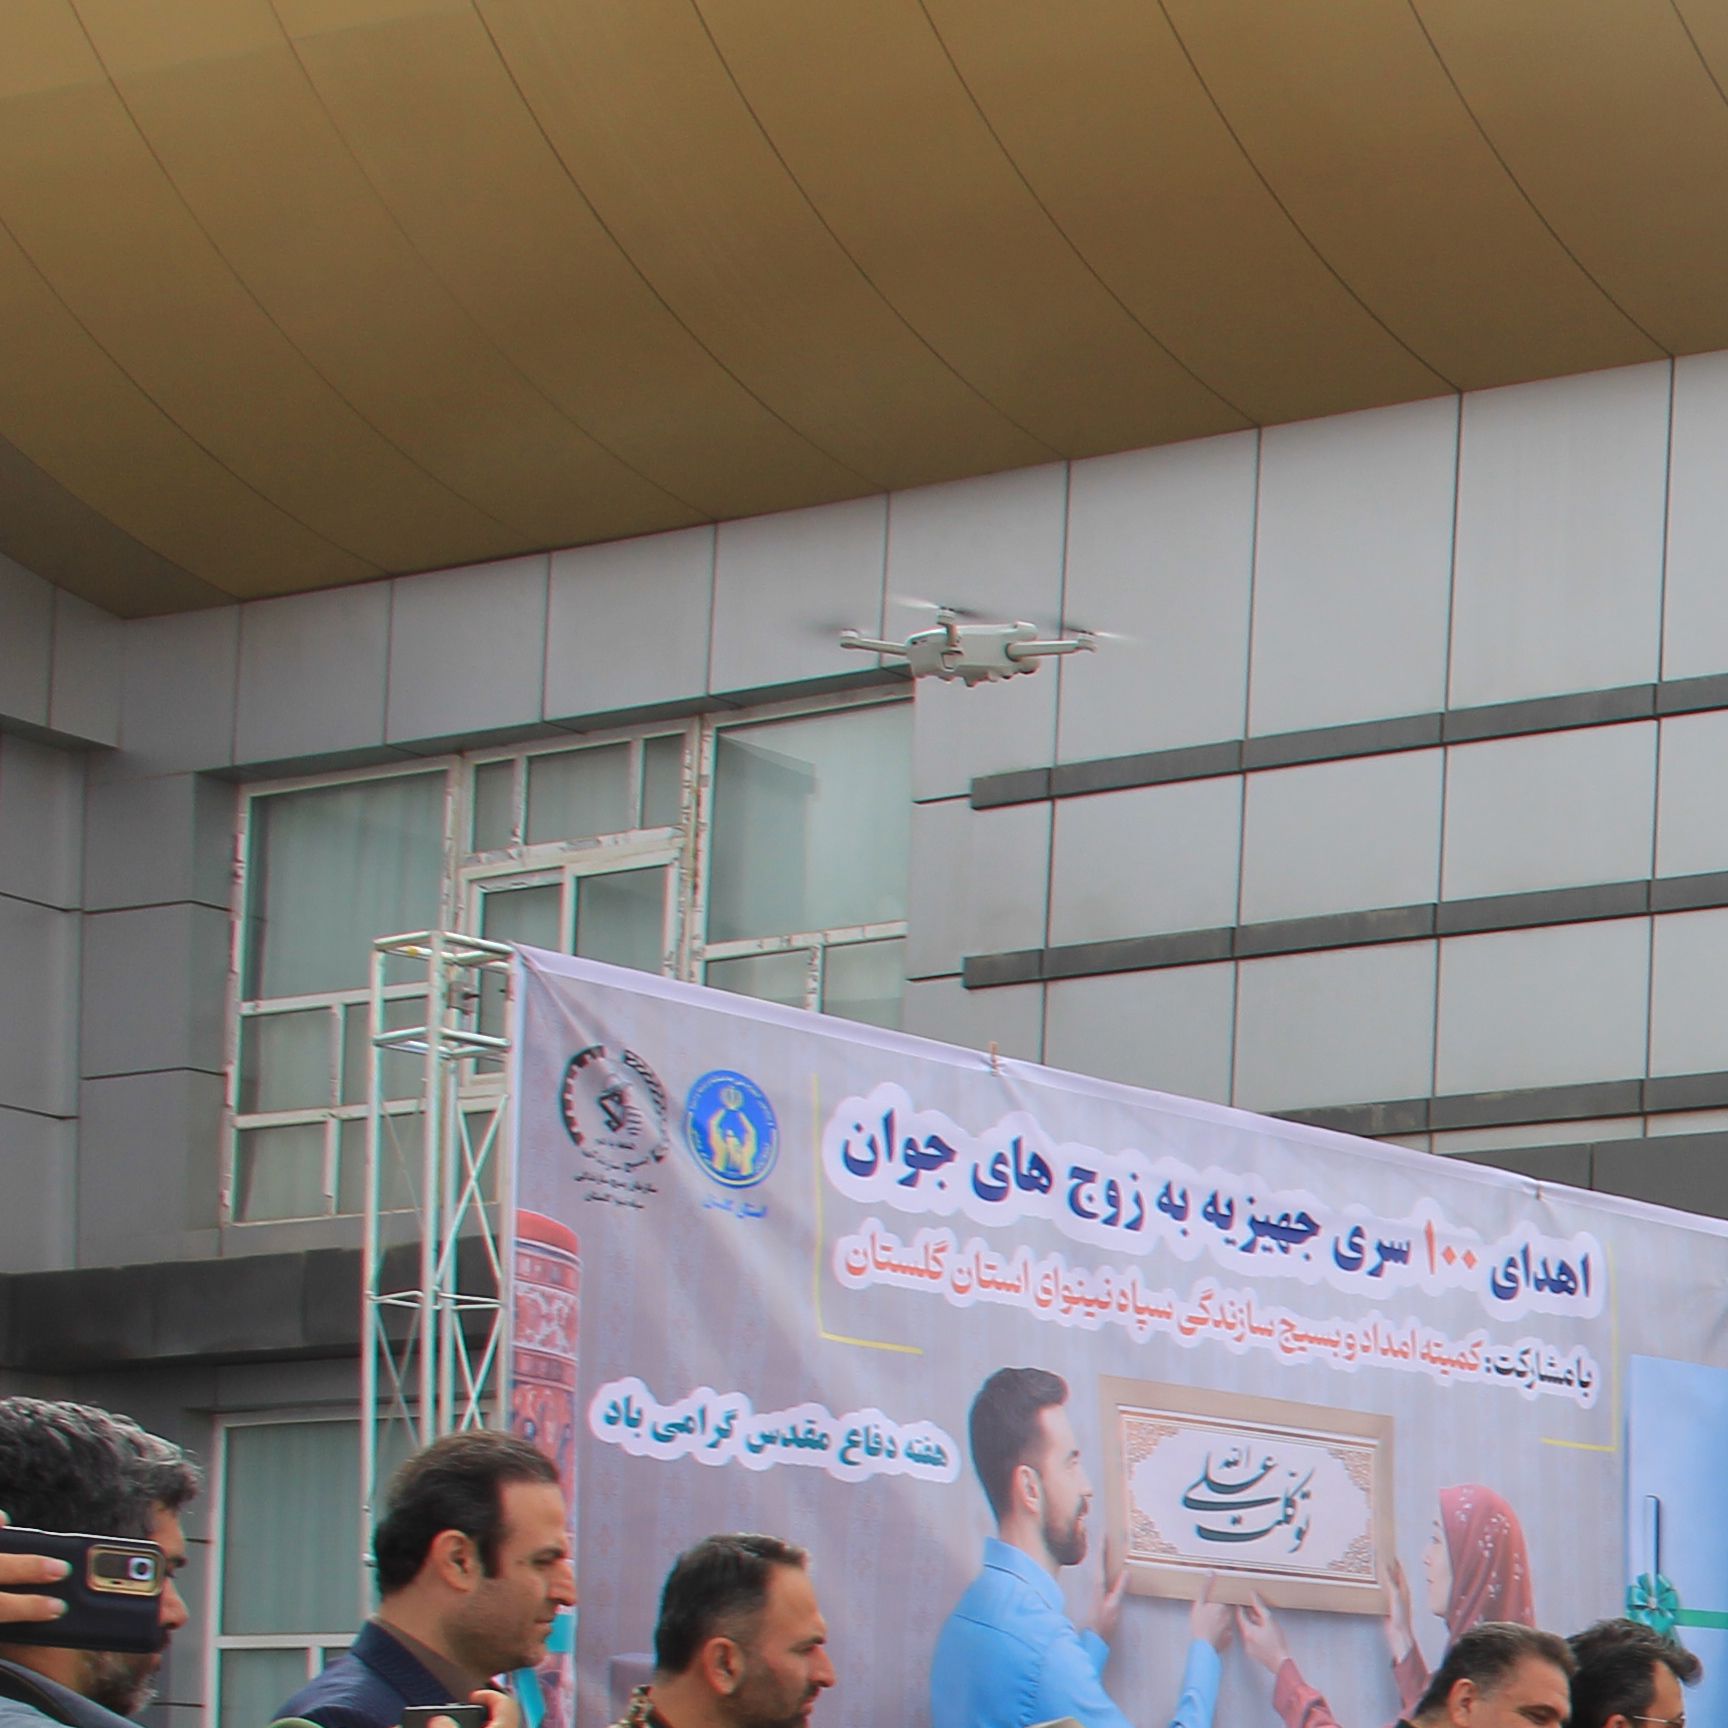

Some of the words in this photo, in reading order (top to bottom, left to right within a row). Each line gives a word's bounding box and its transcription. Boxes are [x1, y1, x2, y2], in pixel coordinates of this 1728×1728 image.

[842, 1107, 957, 1191] جوان
[972, 1136, 1053, 1203] های
[1068, 1166, 1146, 1232] زوج
[1157, 1180, 1191, 1236] به
[1202, 1189, 1321, 1262] جهیزیه
[1424, 1220, 1479, 1275] ۱۰۰
[845, 1232, 950, 1281] گلستان
[950, 1250, 1028, 1295] استان
[1334, 1225, 1411, 1277] سری
[1491, 1242, 1592, 1300] اهدای
[1034, 1266, 1114, 1318] نینوای
[1117, 1279, 1174, 1331] سپاه
[1176, 1289, 1274, 1344] سازندگی
[1279, 1316, 1341, 1358] بسیج
[1343, 1330, 1358, 1362] و
[1360, 1321, 1417, 1361] امداد
[1421, 1339, 1484, 1377] کمیته
[602, 1395, 643, 1439] باد
[651, 1404, 739, 1449] گرامی
[745, 1419, 830, 1454] مقدس
[838, 1422, 898, 1466] دفاع
[904, 1433, 949, 1468] هفته
